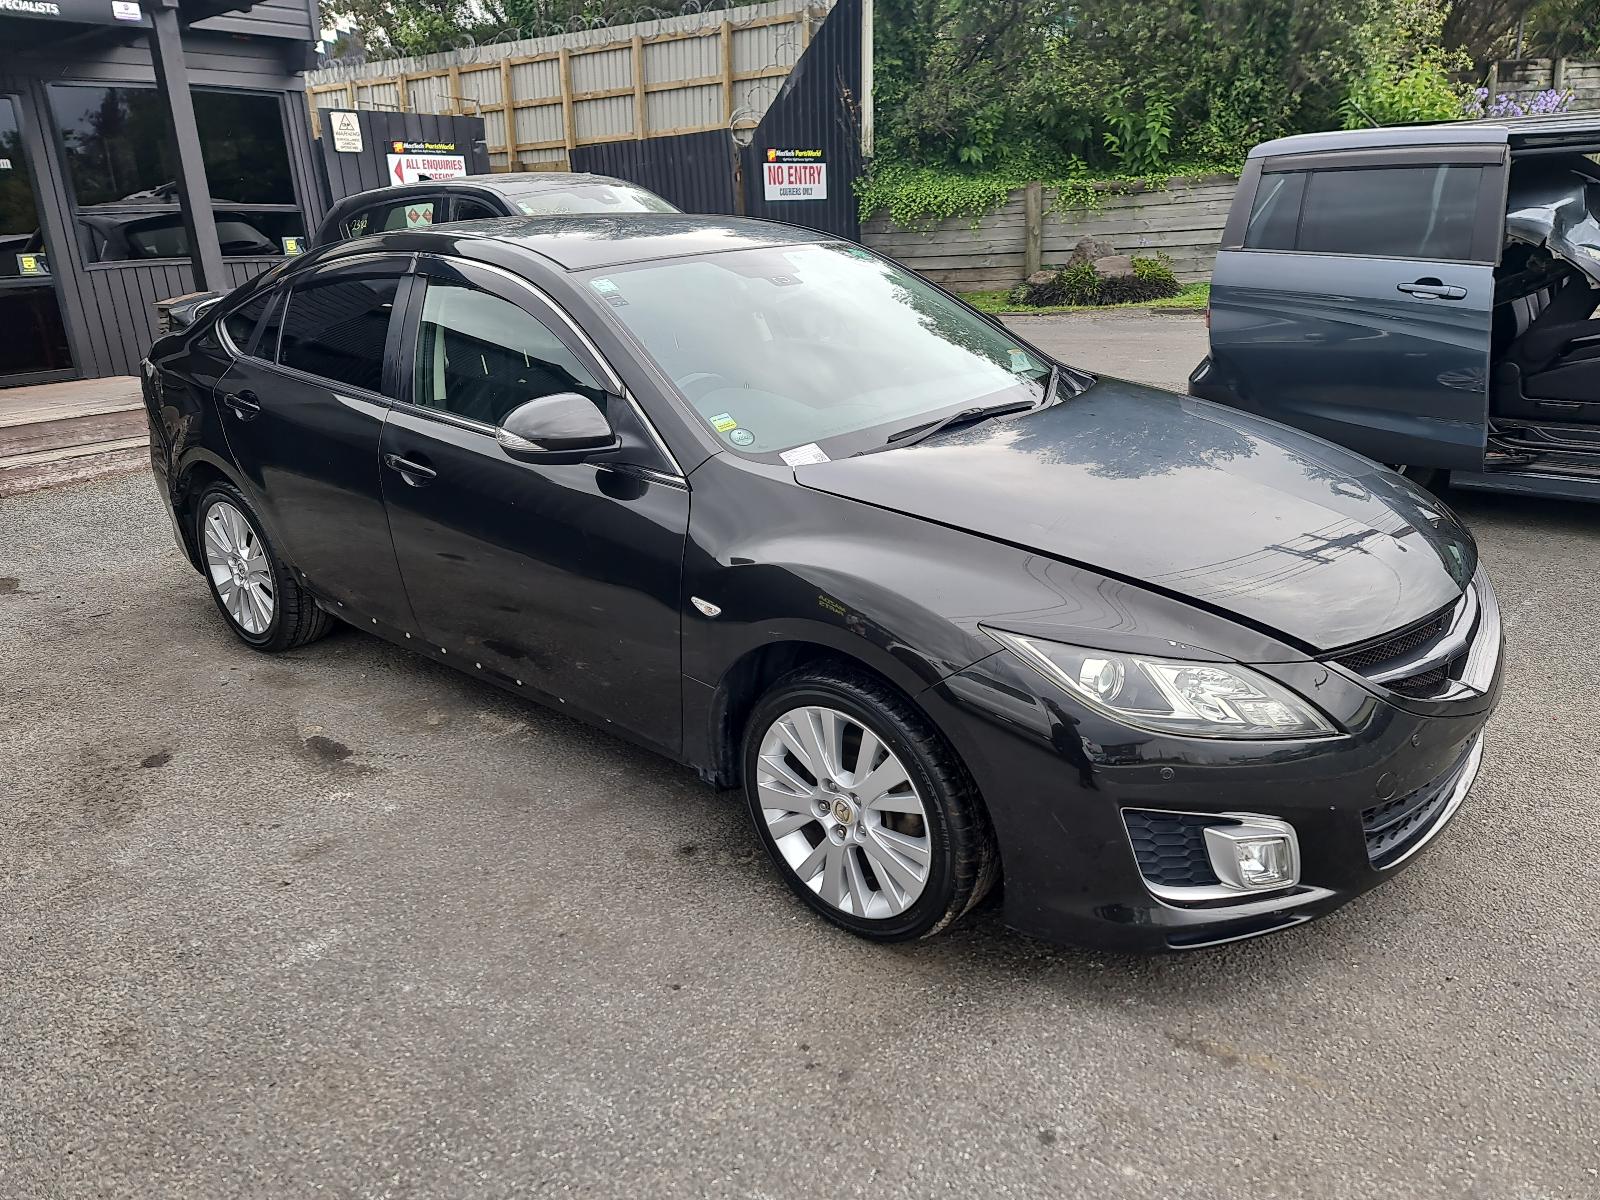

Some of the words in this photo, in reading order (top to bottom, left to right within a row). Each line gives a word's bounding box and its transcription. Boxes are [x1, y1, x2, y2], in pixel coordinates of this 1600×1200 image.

[406, 158, 420, 170] ALL
[422, 158, 463, 171] ENQUIRIES
[767, 165, 784, 185] NO
[788, 165, 822, 185] ENTRY
[780, 187, 801, 196] COURIERS
